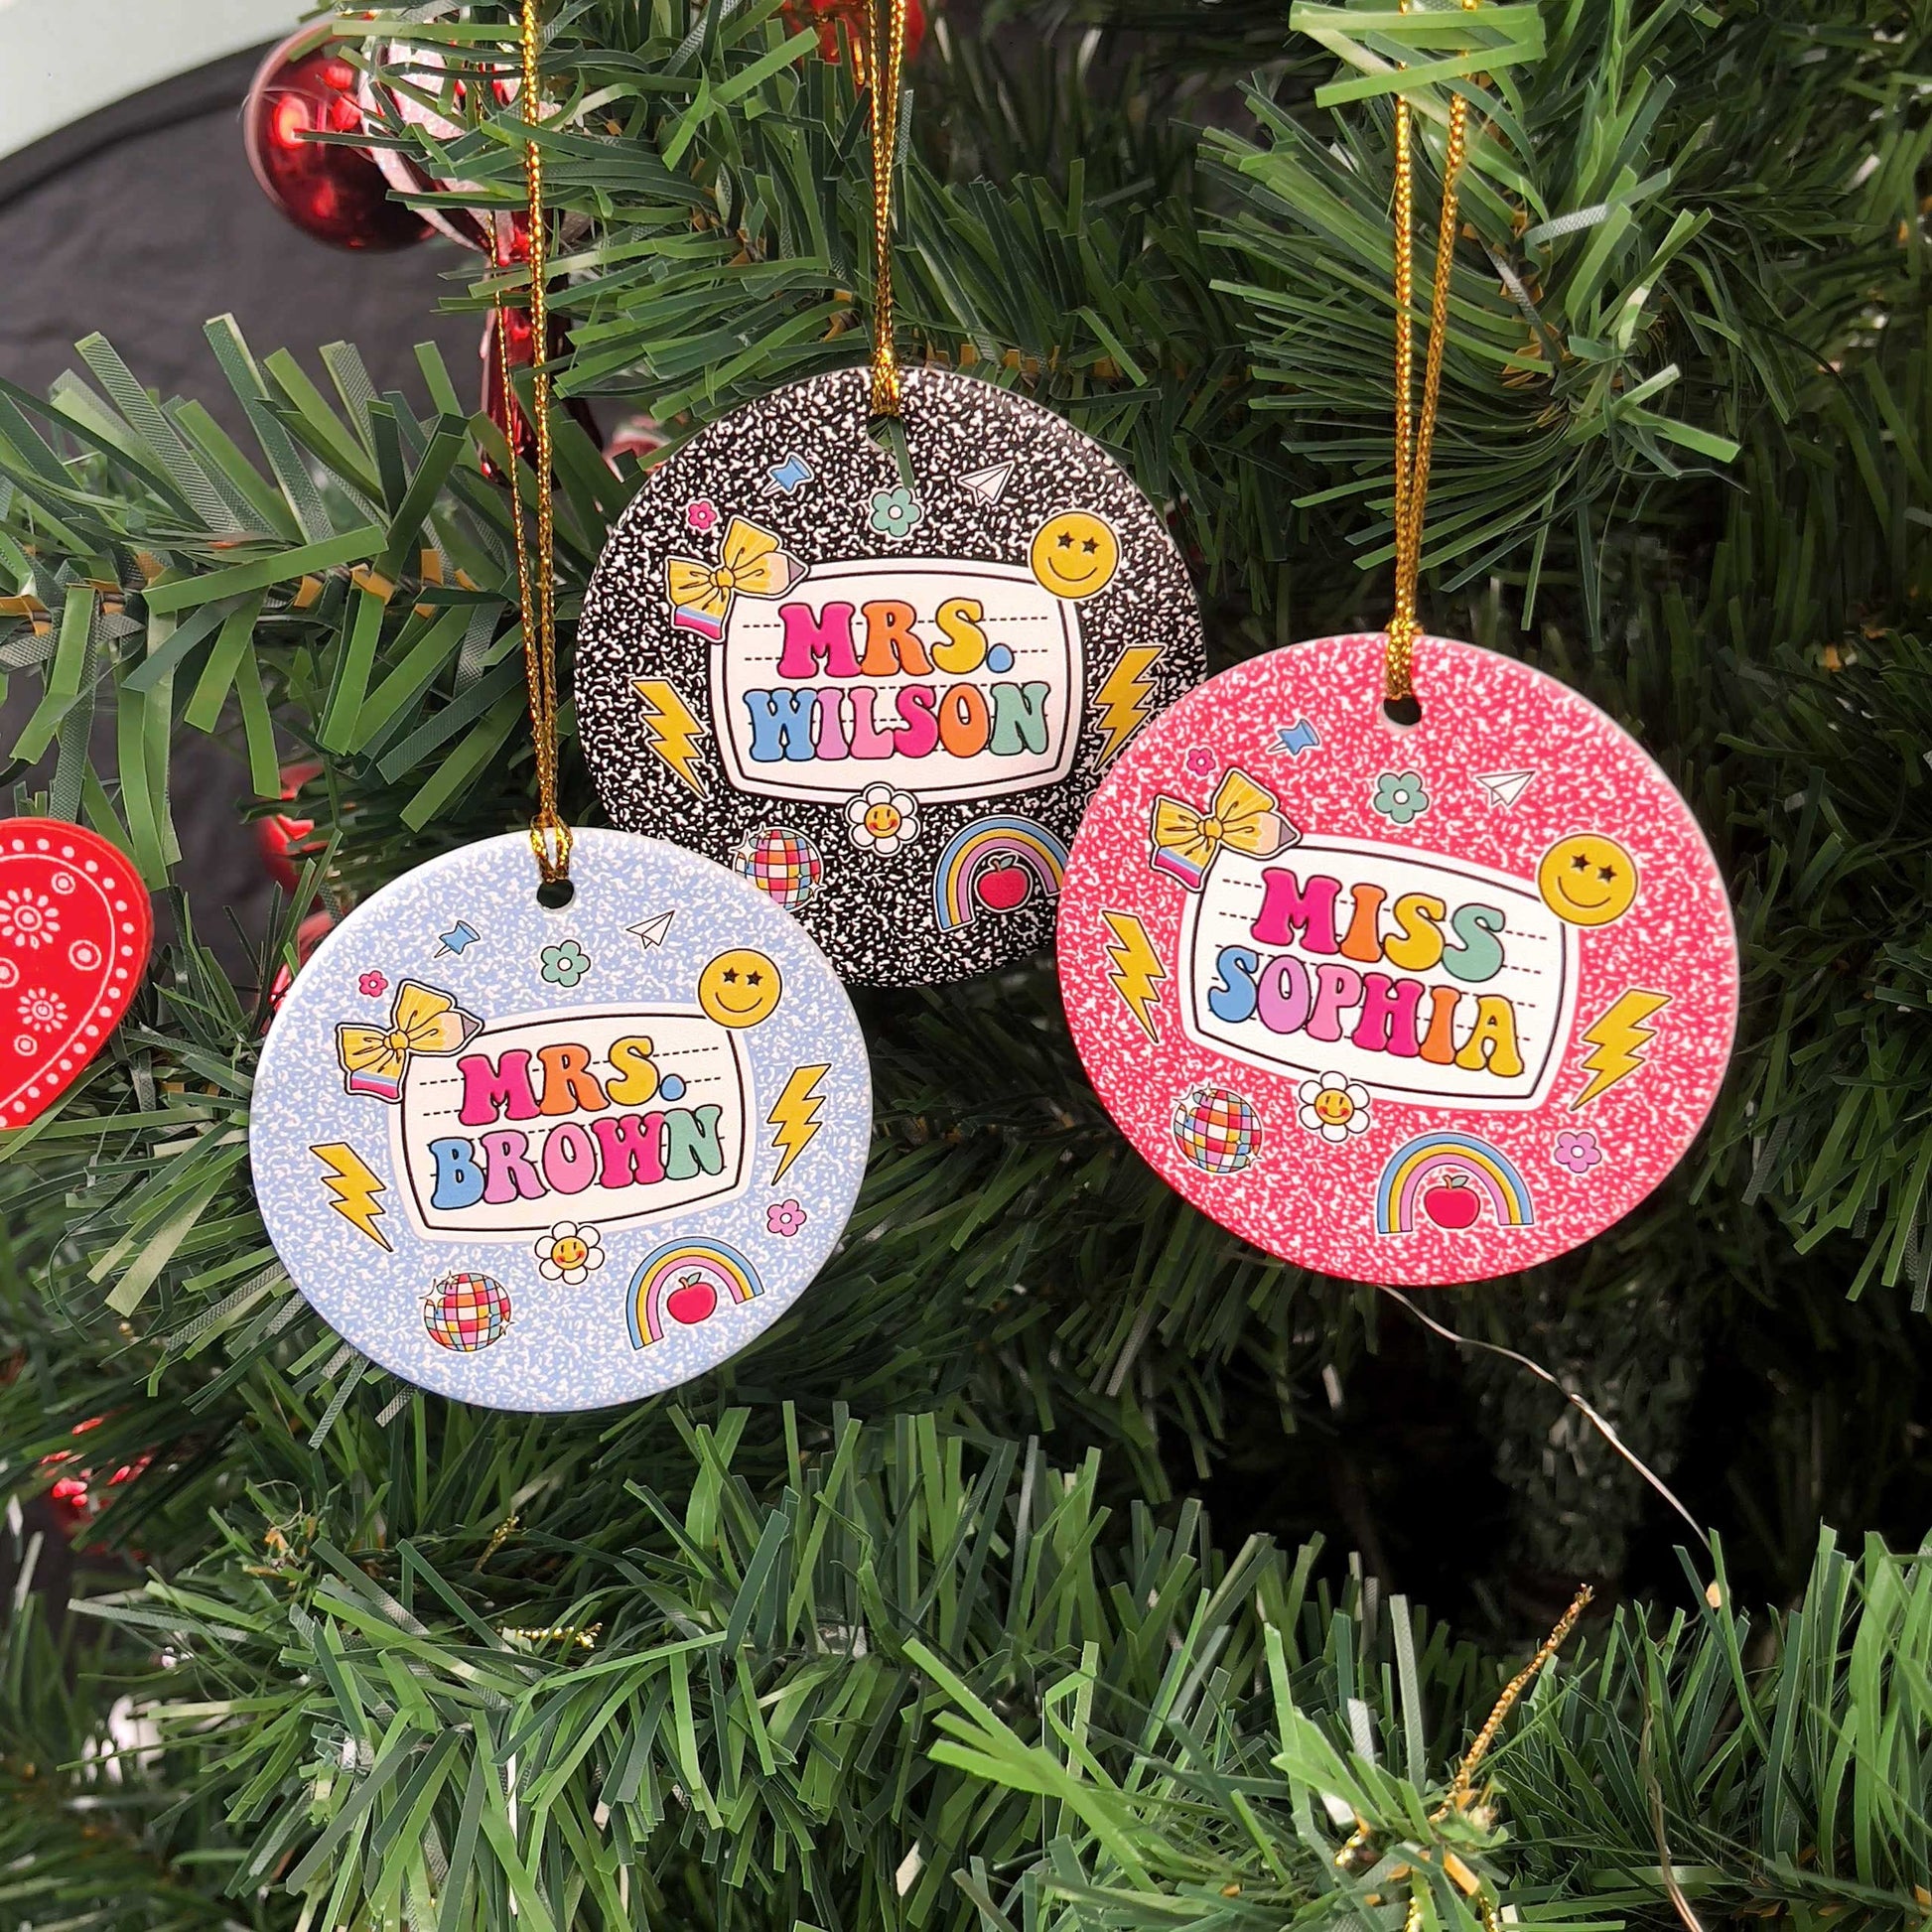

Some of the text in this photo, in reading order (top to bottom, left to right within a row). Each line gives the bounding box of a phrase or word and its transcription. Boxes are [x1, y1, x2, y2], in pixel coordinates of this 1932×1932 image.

[776, 597, 1015, 679] MRS.
[743, 681, 1051, 762] WILSON
[1250, 867, 1506, 983] MISS
[1207, 944, 1525, 1077] SOPHIA
[457, 1035, 687, 1127] MRS.
[428, 1104, 723, 1210] BROWN
